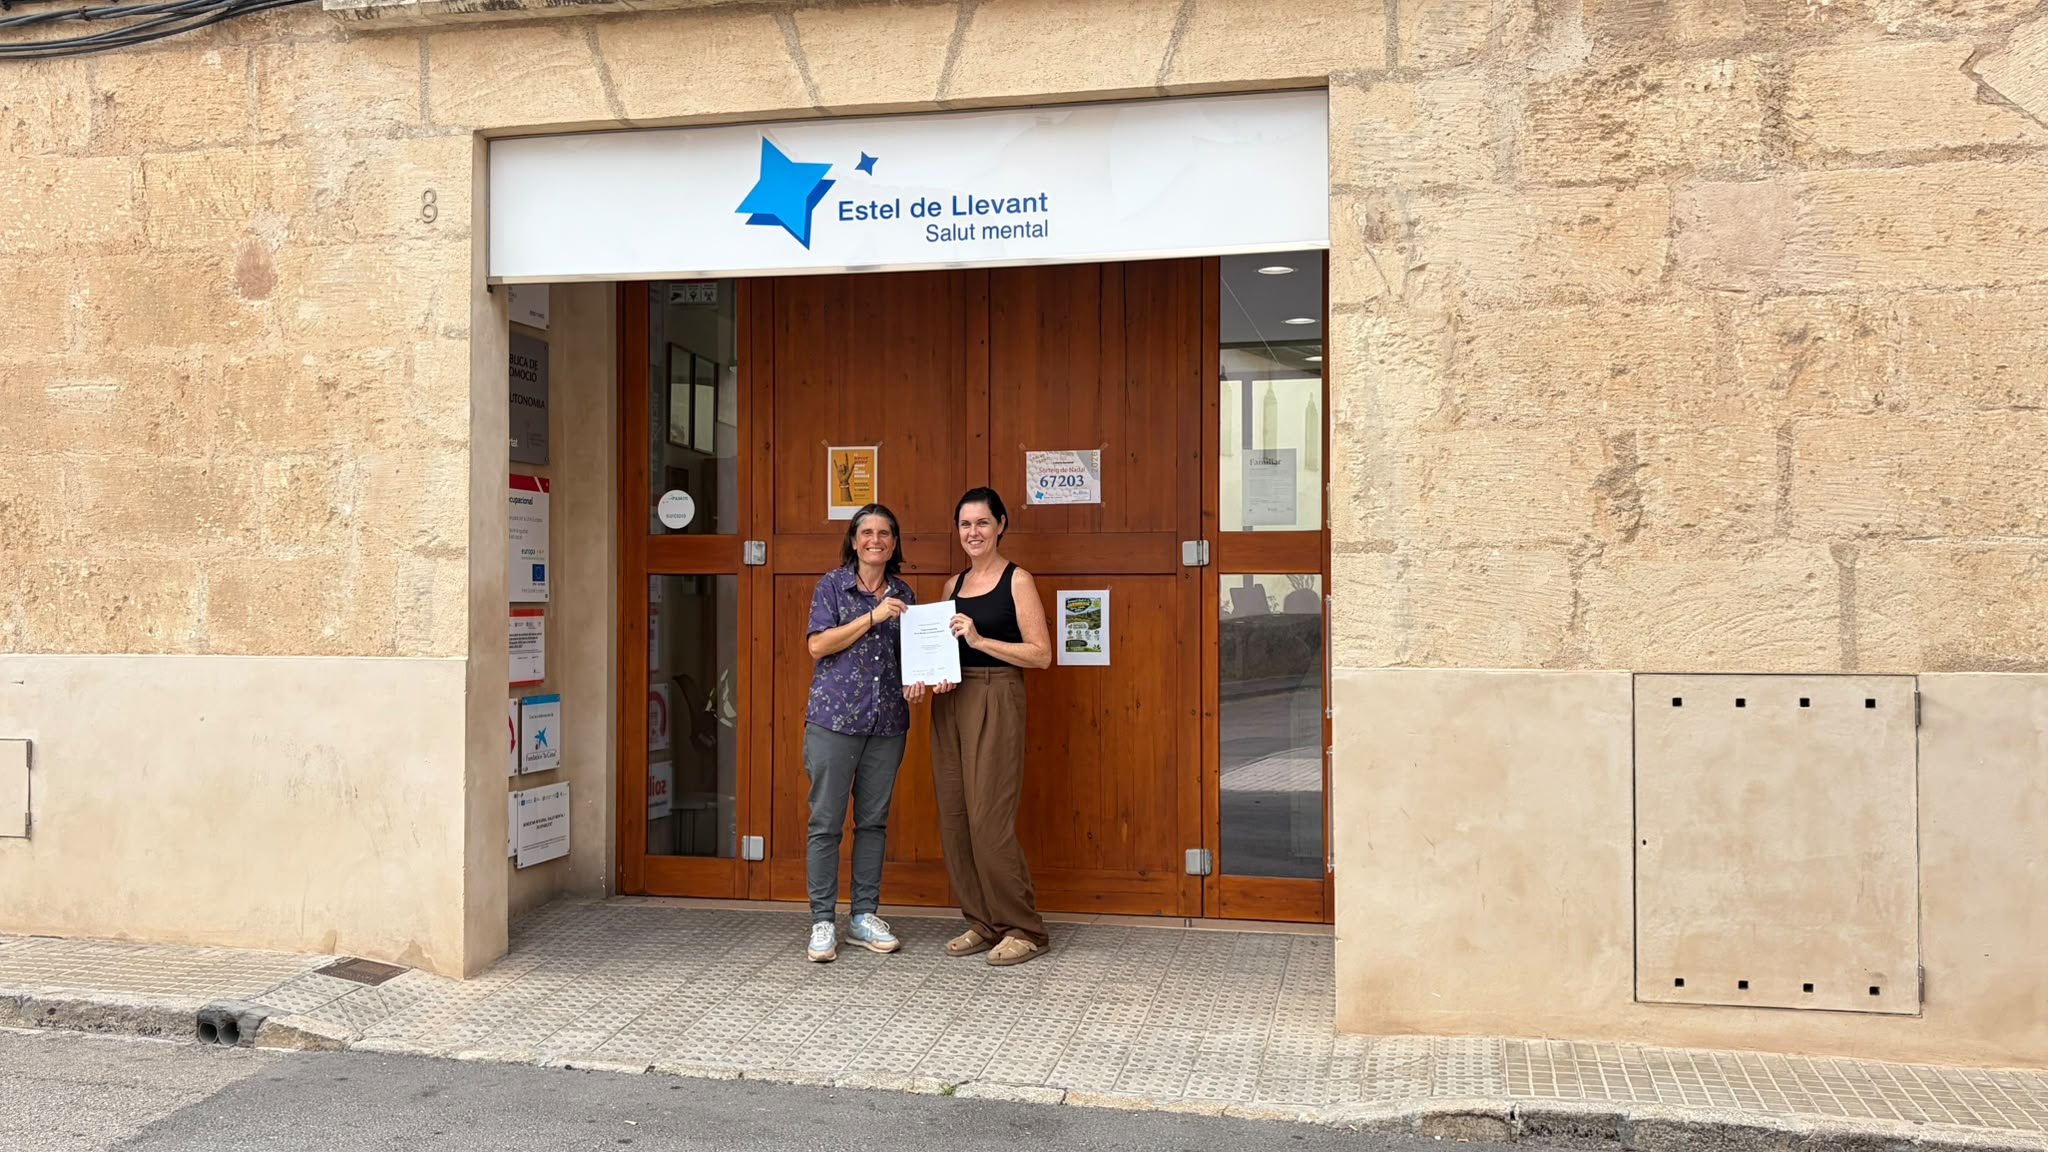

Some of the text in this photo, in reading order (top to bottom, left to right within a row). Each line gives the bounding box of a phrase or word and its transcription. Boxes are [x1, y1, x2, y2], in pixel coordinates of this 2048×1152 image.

[421, 187, 438, 224] 8
[838, 192, 1048, 221] Estel de Llevant
[926, 219, 1048, 242] Salut mental
[529, 358, 539, 371] DE
[1040, 475, 1085, 488] 67203
